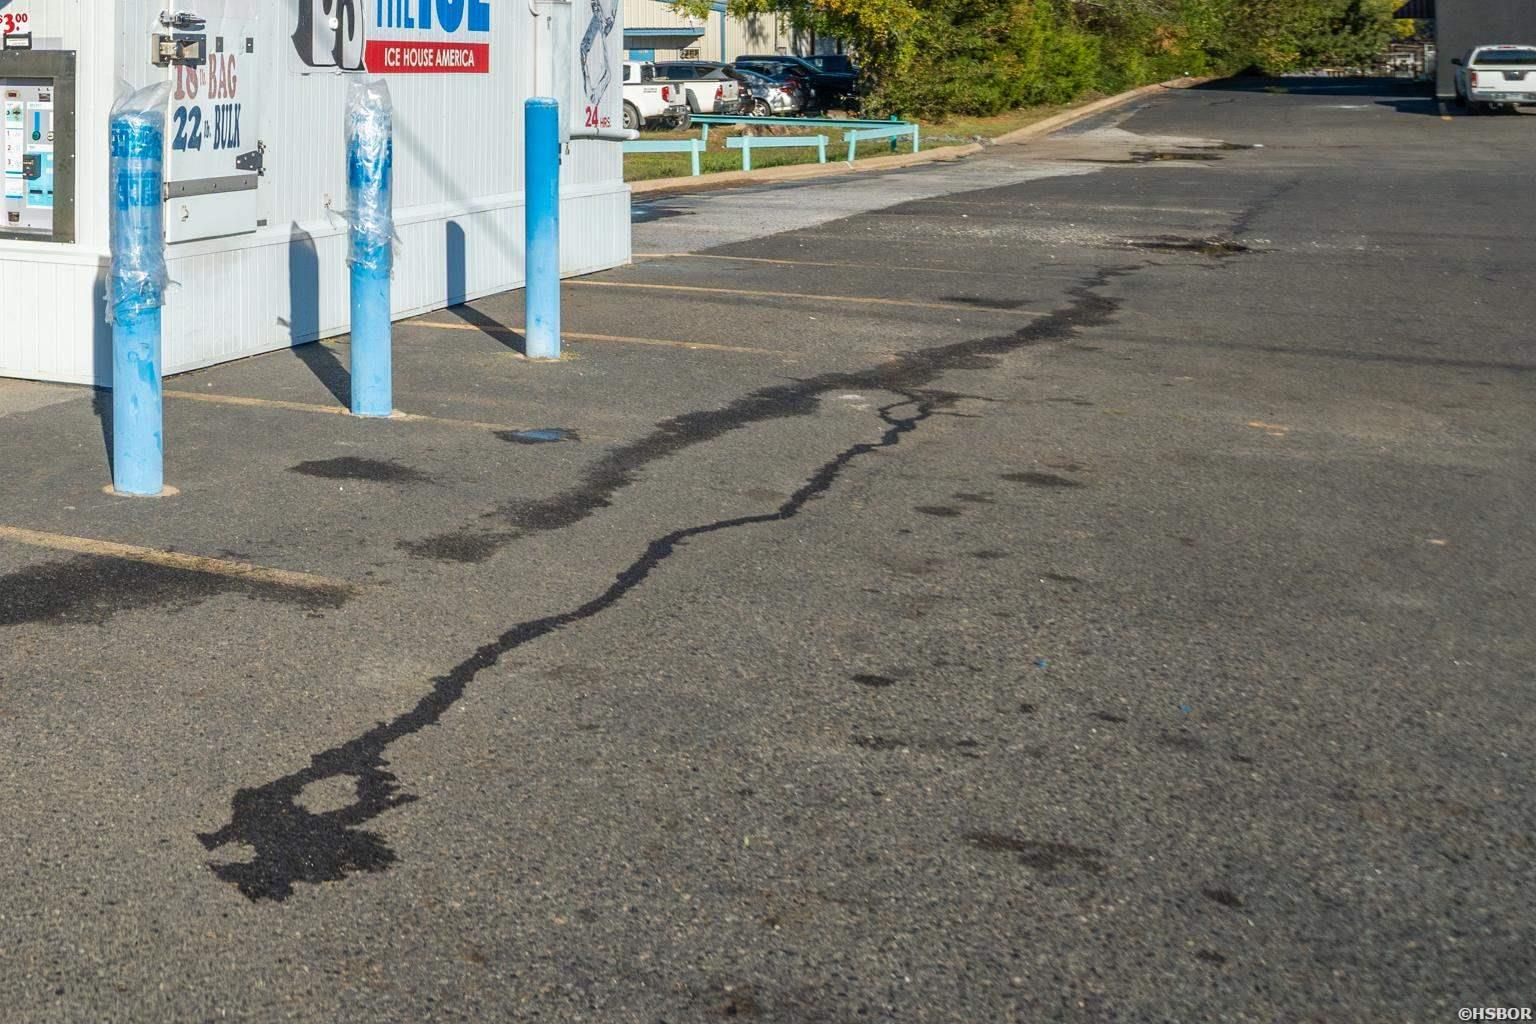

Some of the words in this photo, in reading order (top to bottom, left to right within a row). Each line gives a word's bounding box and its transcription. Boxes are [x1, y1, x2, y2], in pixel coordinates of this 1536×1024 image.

[384, 47, 401, 66] ICE
[402, 49, 434, 67] HOUSE
[435, 51, 475, 68] AMERICA
[208, 53, 237, 99] BAG
[172, 105, 202, 152] 22
[213, 103, 241, 150] BULK
[585, 106, 598, 128] 24
